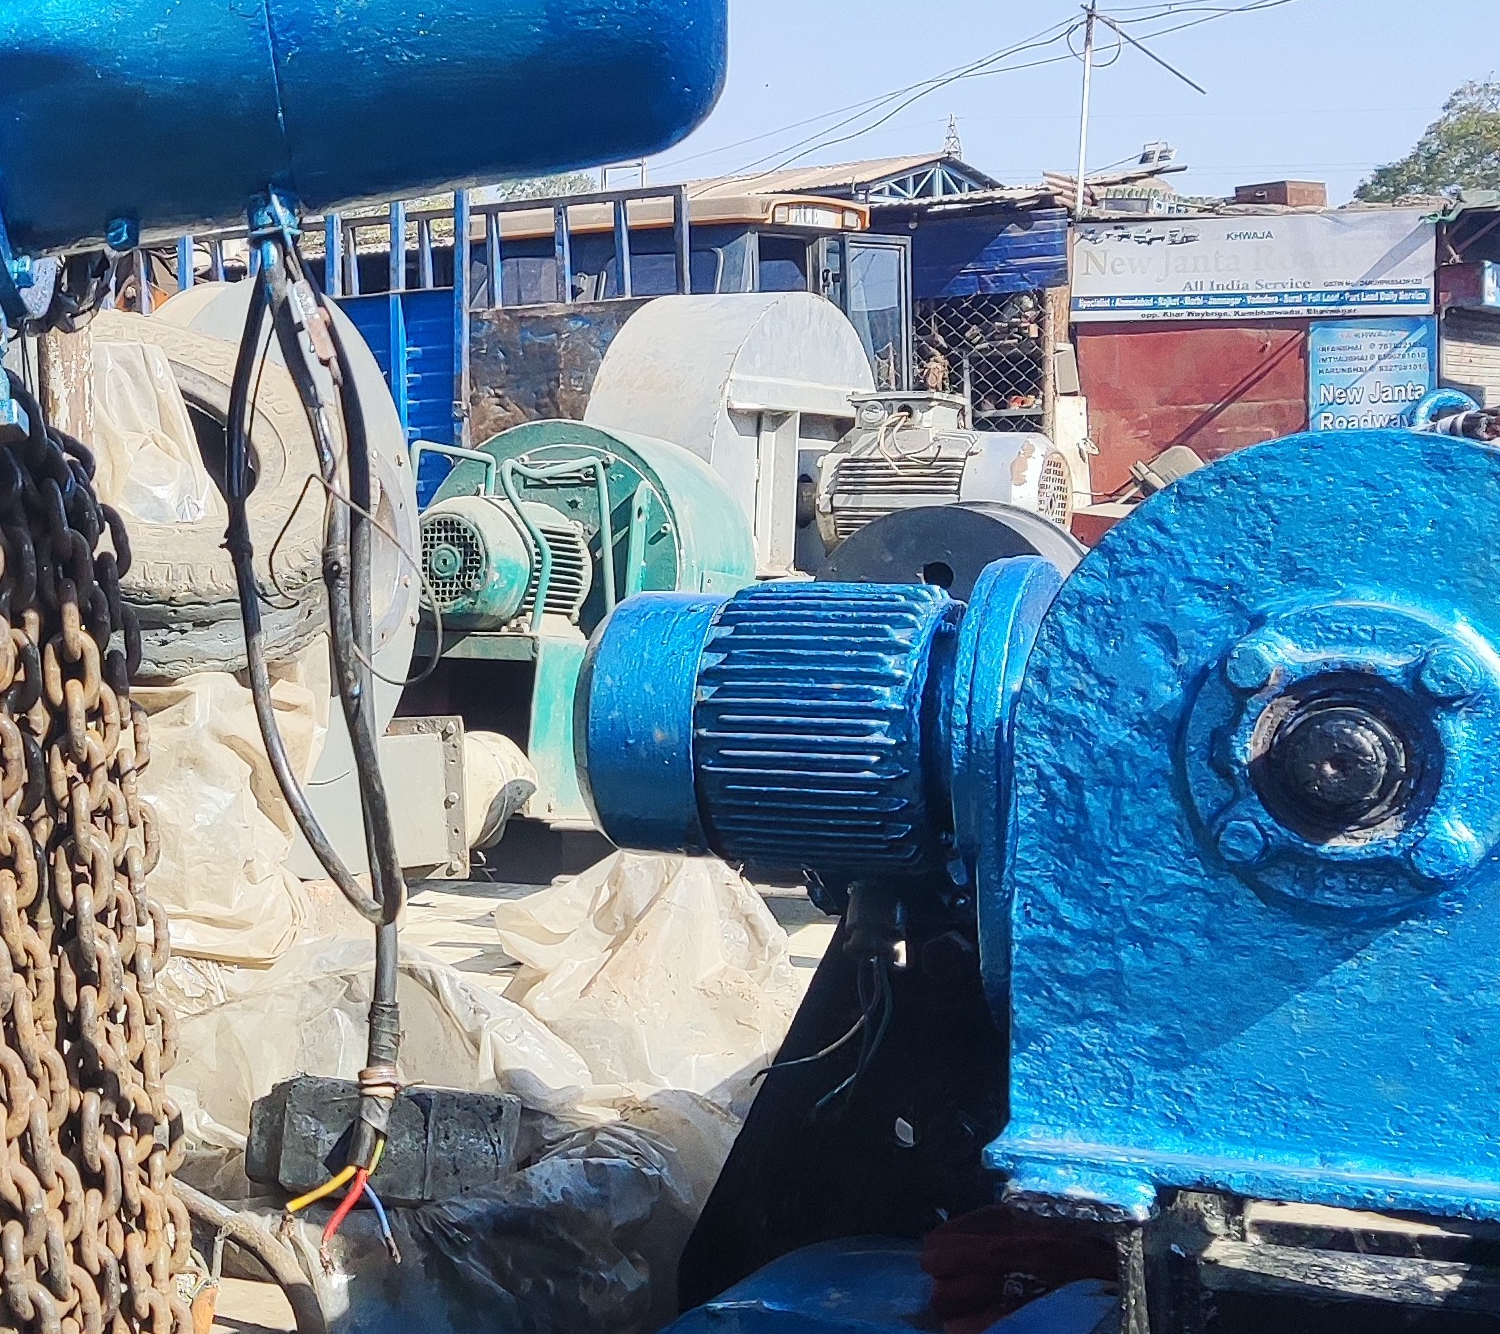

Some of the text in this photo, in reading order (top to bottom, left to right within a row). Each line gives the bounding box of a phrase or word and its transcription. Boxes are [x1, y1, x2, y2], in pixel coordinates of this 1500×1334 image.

[1226, 230, 1275, 242] KHWAJA
[1182, 280, 1205, 292] All
[1209, 279, 1250, 291] India
[1254, 277, 1312, 291] Service
[1320, 380, 1426, 406] New Janta
[1320, 409, 1410, 431] Roadwa
